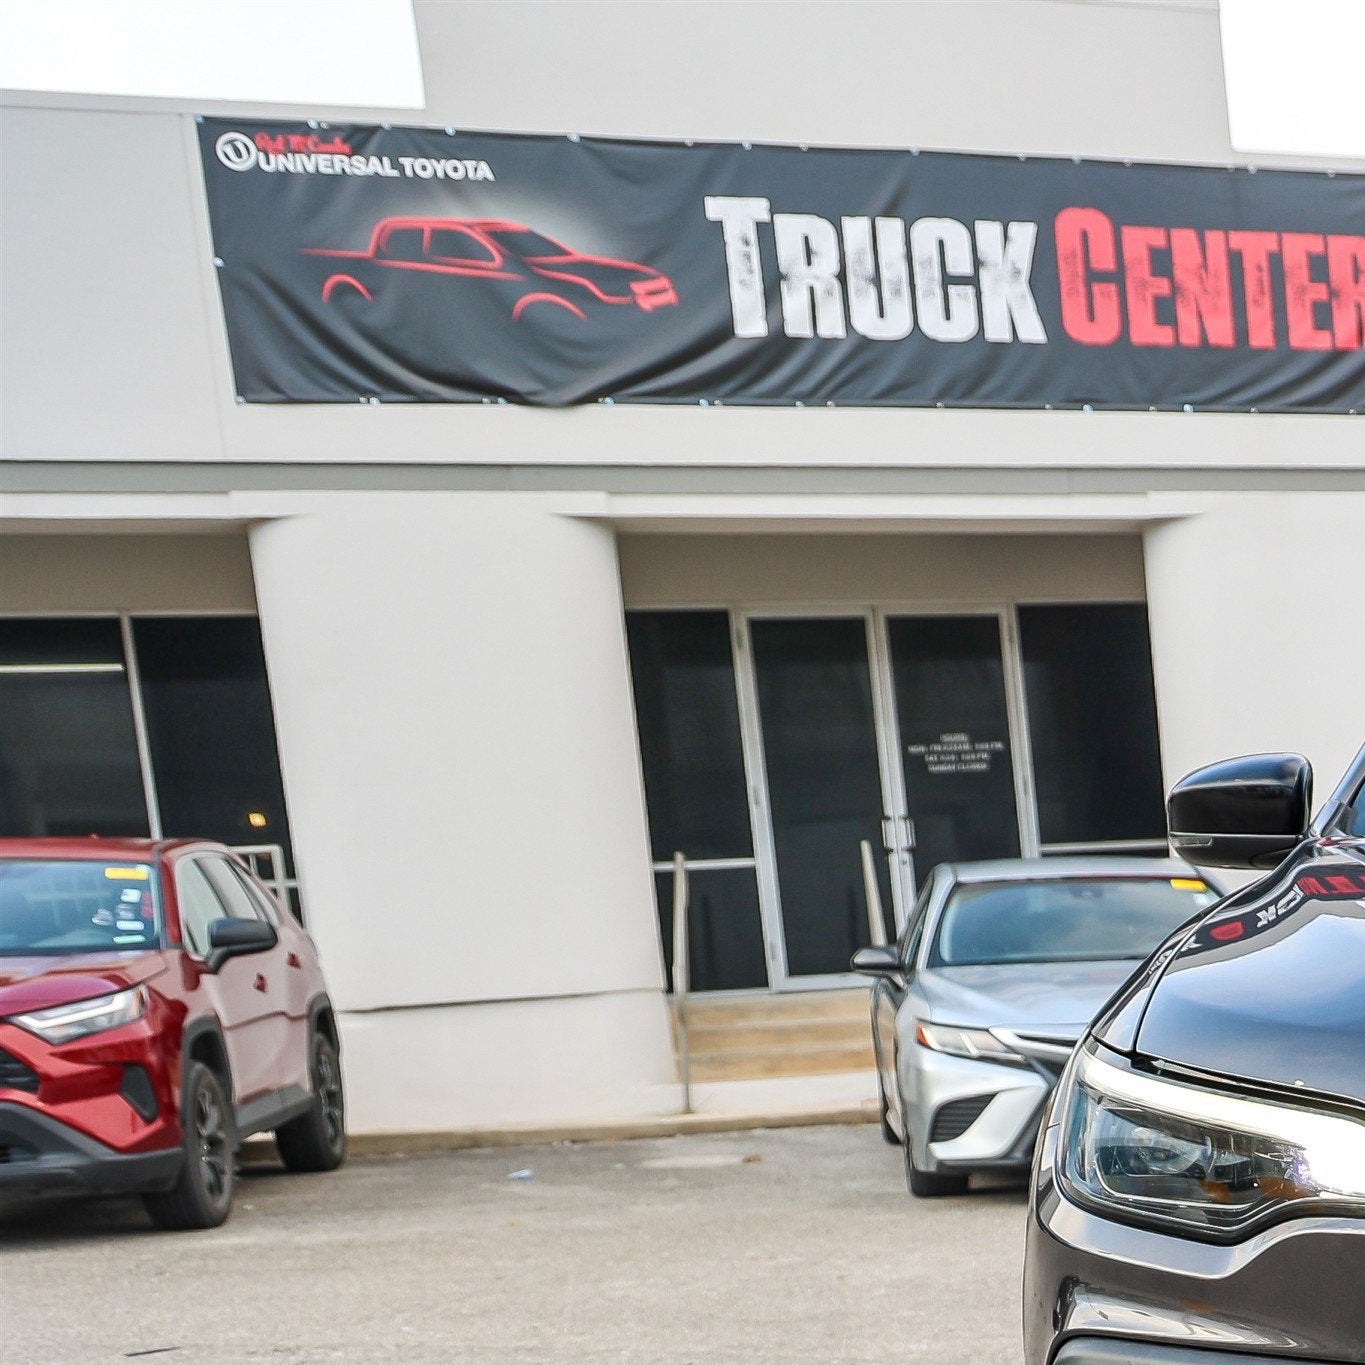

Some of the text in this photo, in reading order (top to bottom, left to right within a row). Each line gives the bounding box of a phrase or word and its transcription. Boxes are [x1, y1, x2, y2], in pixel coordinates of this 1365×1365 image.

[257, 151, 495, 182] UNIVERSAL TOYOTA
[703, 195, 1048, 346] TRUCK
